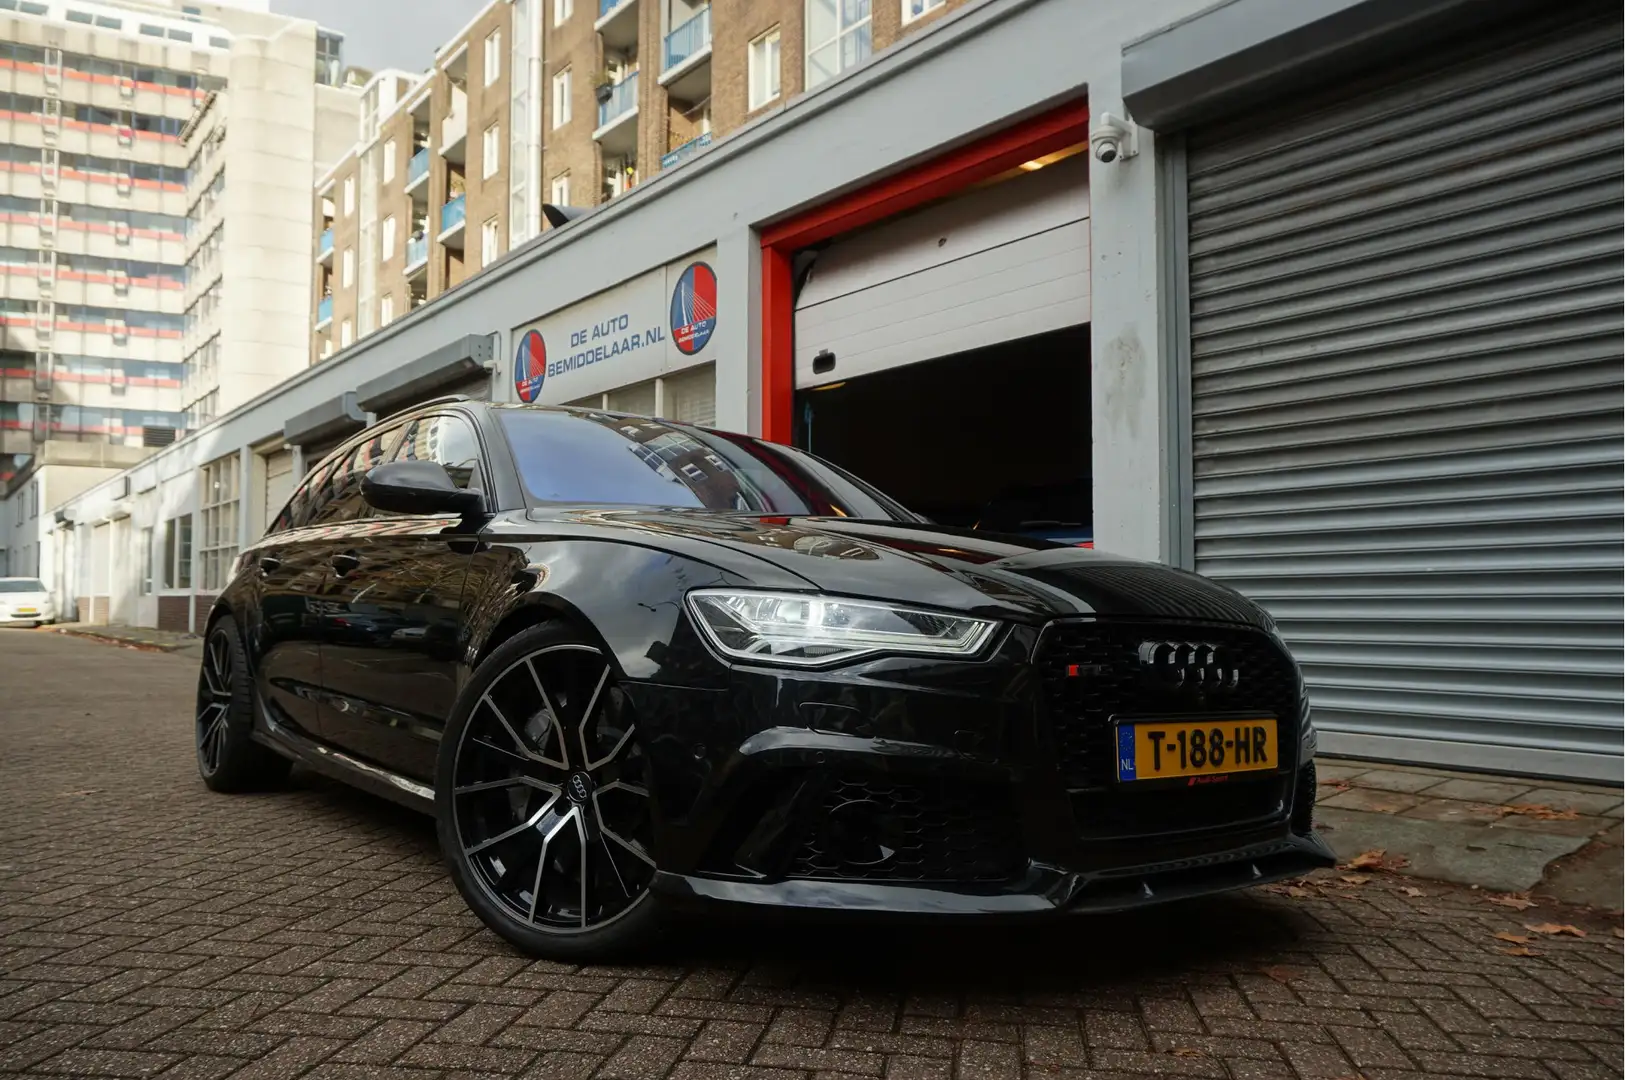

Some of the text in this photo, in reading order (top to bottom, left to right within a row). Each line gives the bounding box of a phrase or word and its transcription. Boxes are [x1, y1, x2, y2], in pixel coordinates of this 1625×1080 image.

[571, 314, 629, 348] DE AUTO
[690, 320, 707, 332] AUTO
[548, 326, 665, 378] BEMIDDELAAR.NL
[1121, 759, 1134, 771] NL
[1147, 727, 1268, 772] T-188-HR
